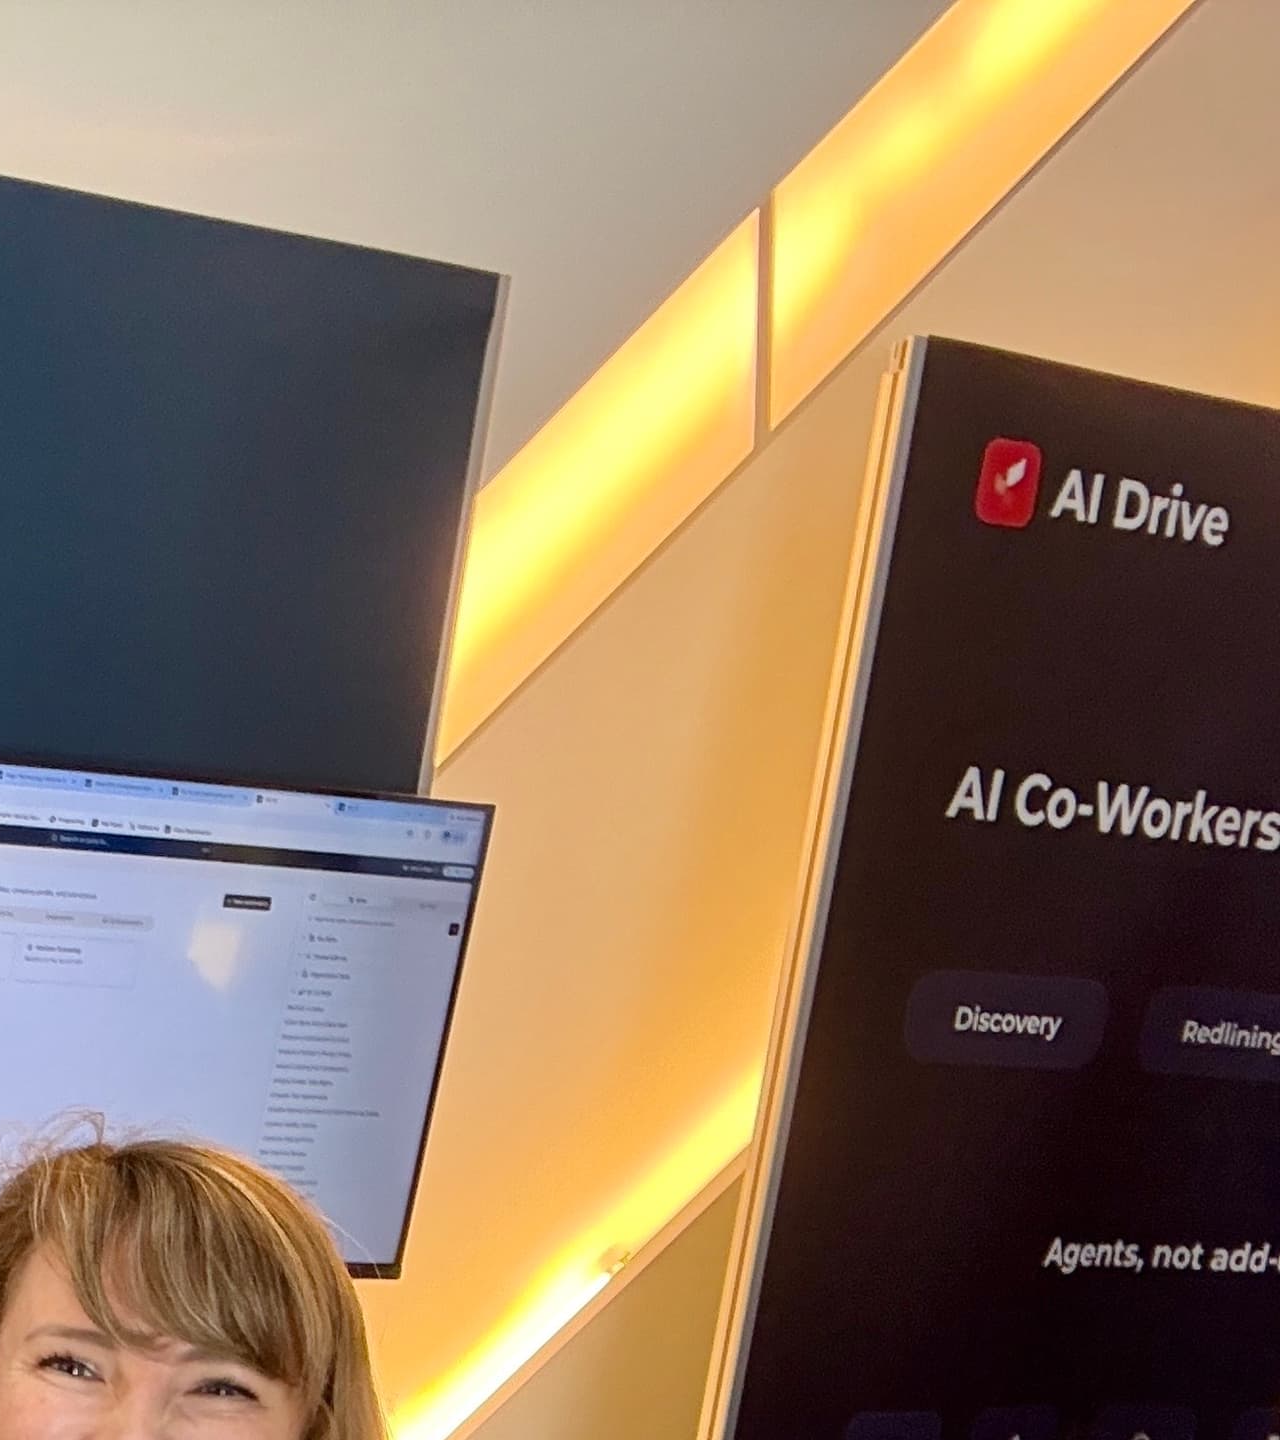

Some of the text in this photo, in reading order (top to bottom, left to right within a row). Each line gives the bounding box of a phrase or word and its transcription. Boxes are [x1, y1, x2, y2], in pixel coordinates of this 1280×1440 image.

[1050, 469, 1229, 546] AI Drive
[945, 766, 1280, 851] AI Co-Workers
[954, 1005, 1062, 1042] Discovery
[1182, 1020, 1280, 1056] Redlining
[1043, 1236, 1280, 1274] Agents, not add-
